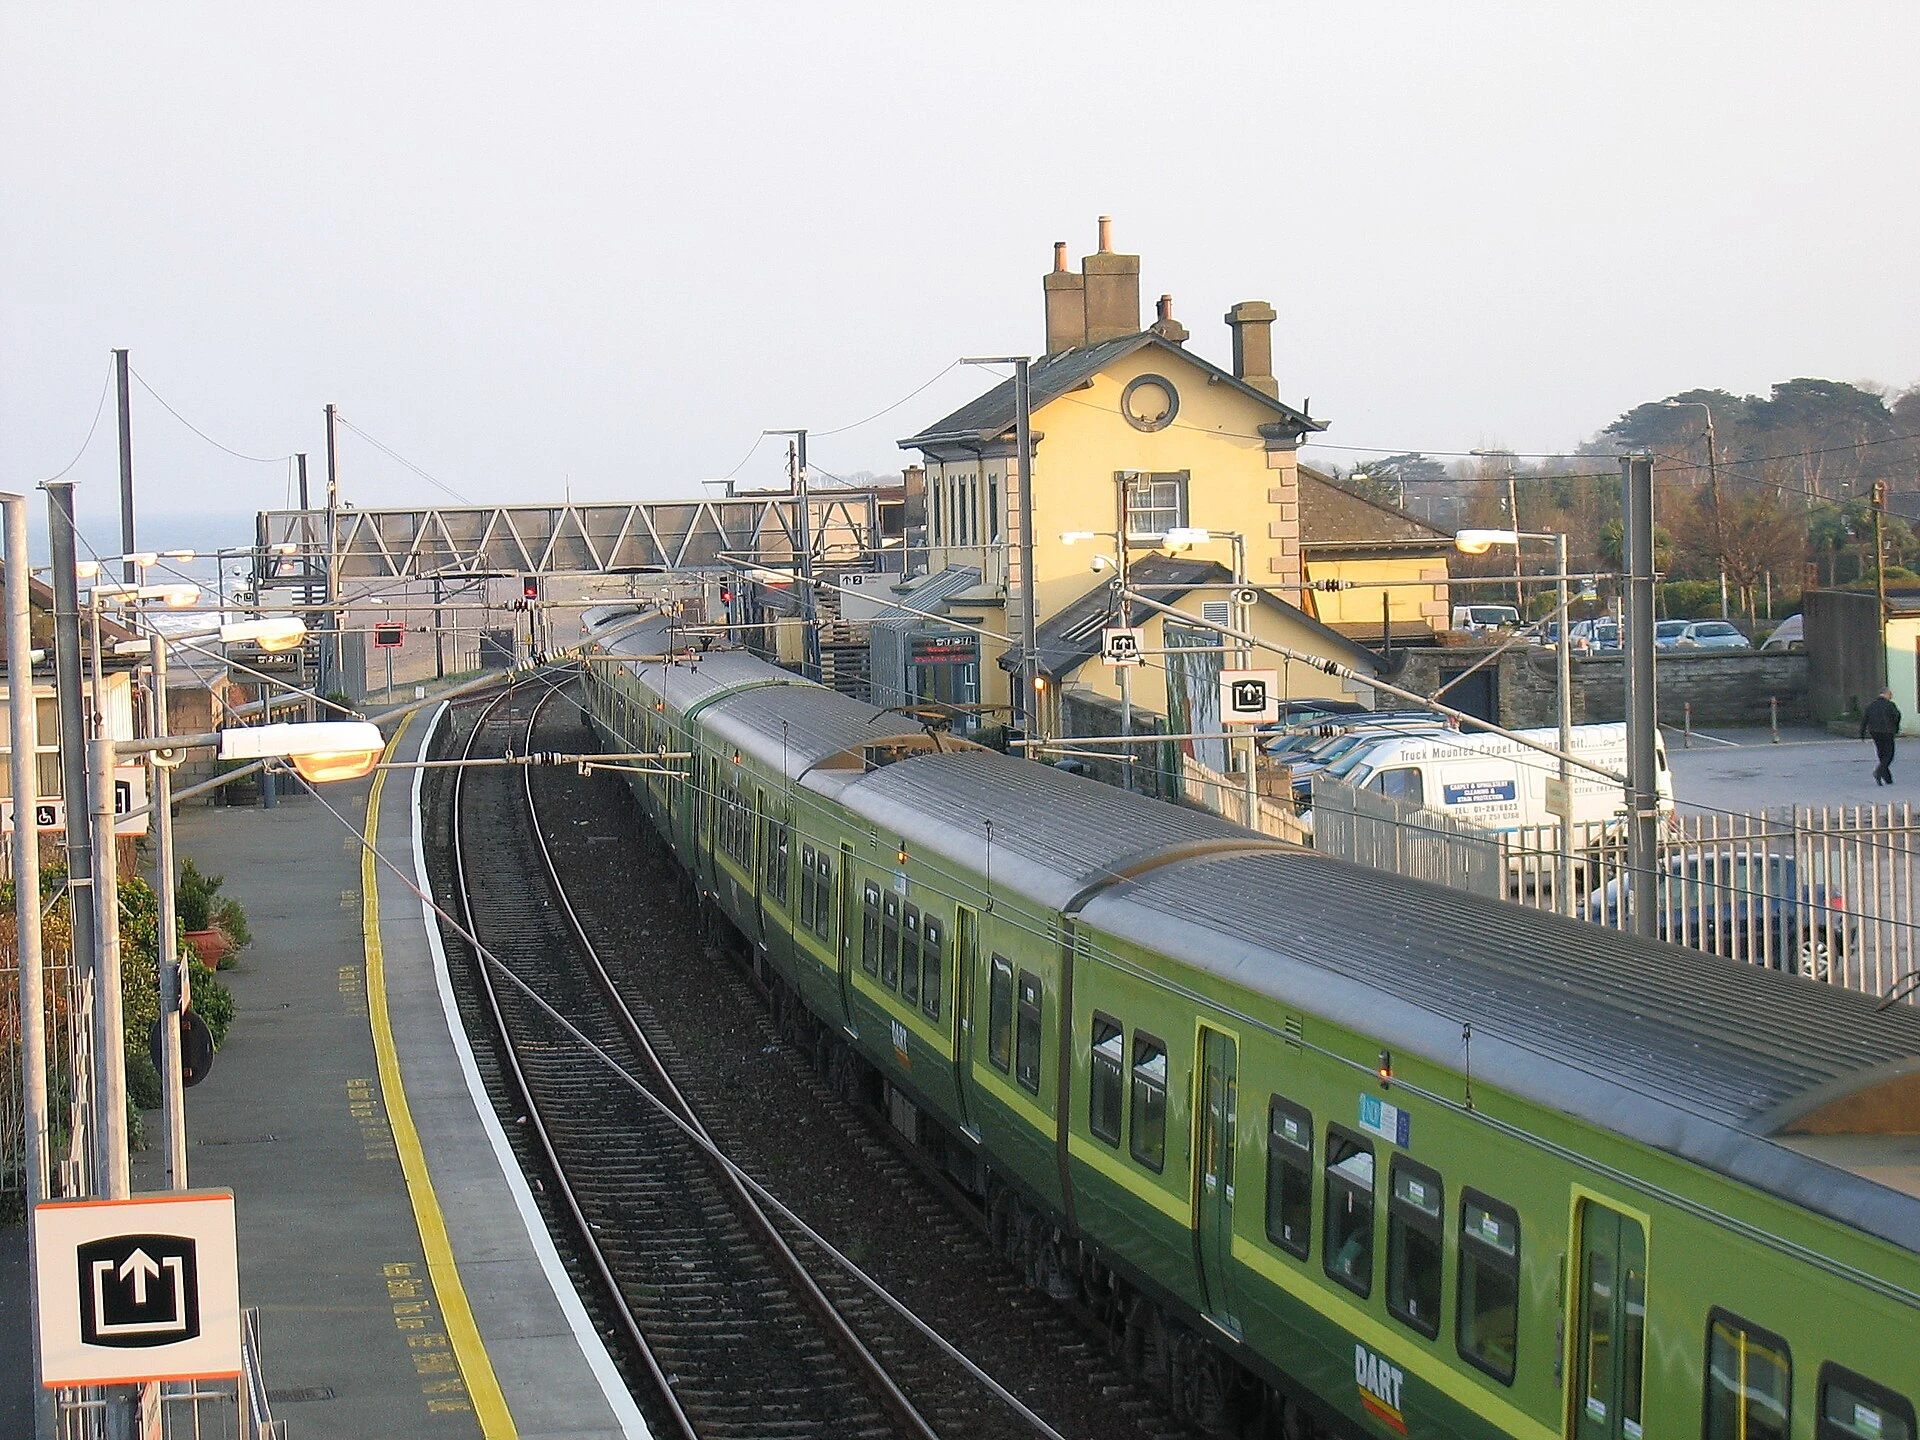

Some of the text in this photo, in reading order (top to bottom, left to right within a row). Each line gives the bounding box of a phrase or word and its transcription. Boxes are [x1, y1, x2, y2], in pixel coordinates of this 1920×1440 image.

[1400, 750, 1427, 762] Truck
[1432, 745, 1474, 759] Mounted
[1480, 742, 1512, 755] Carpet
[1355, 1343, 1404, 1412] DART
